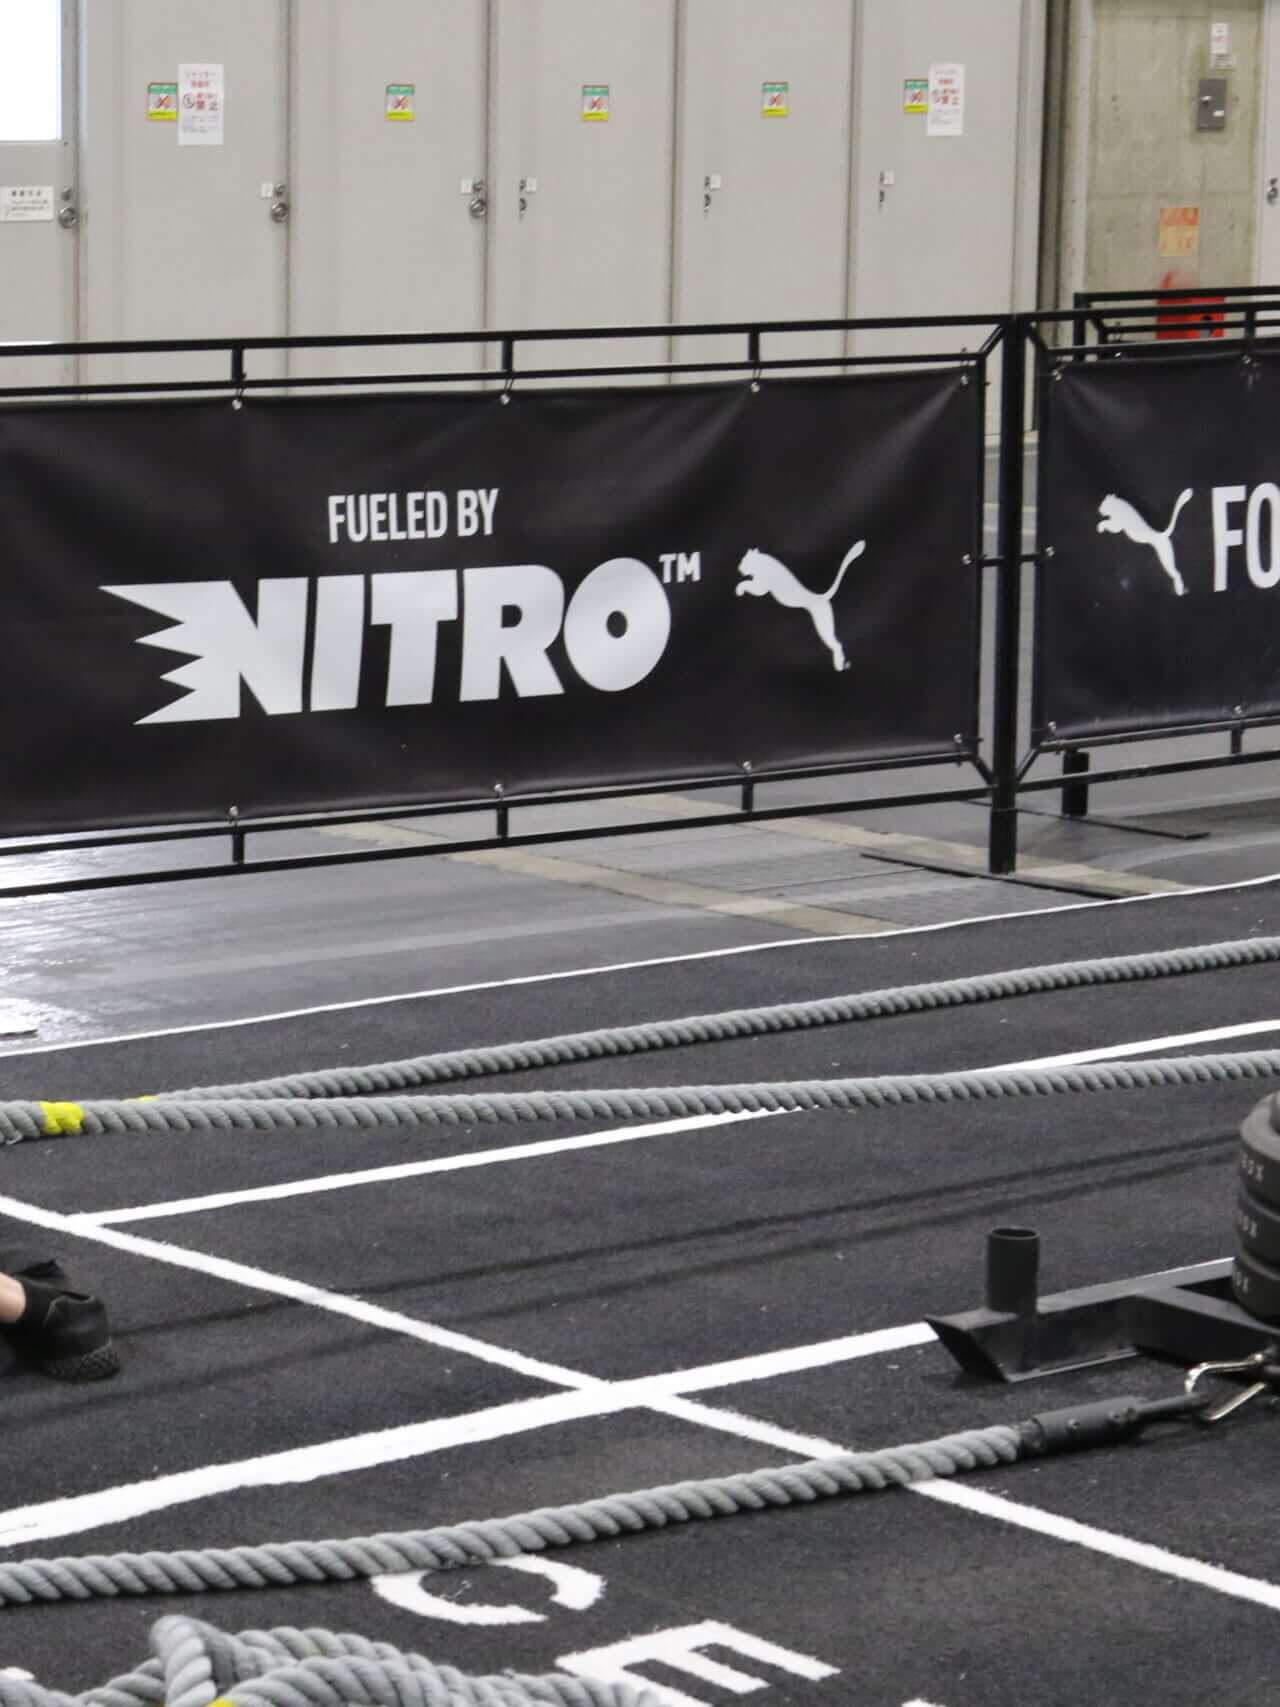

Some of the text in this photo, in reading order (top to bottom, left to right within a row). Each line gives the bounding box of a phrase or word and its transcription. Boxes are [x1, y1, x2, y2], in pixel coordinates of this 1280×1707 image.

[328, 489, 498, 543] FUELED BY
[100, 557, 670, 724] NITRO
